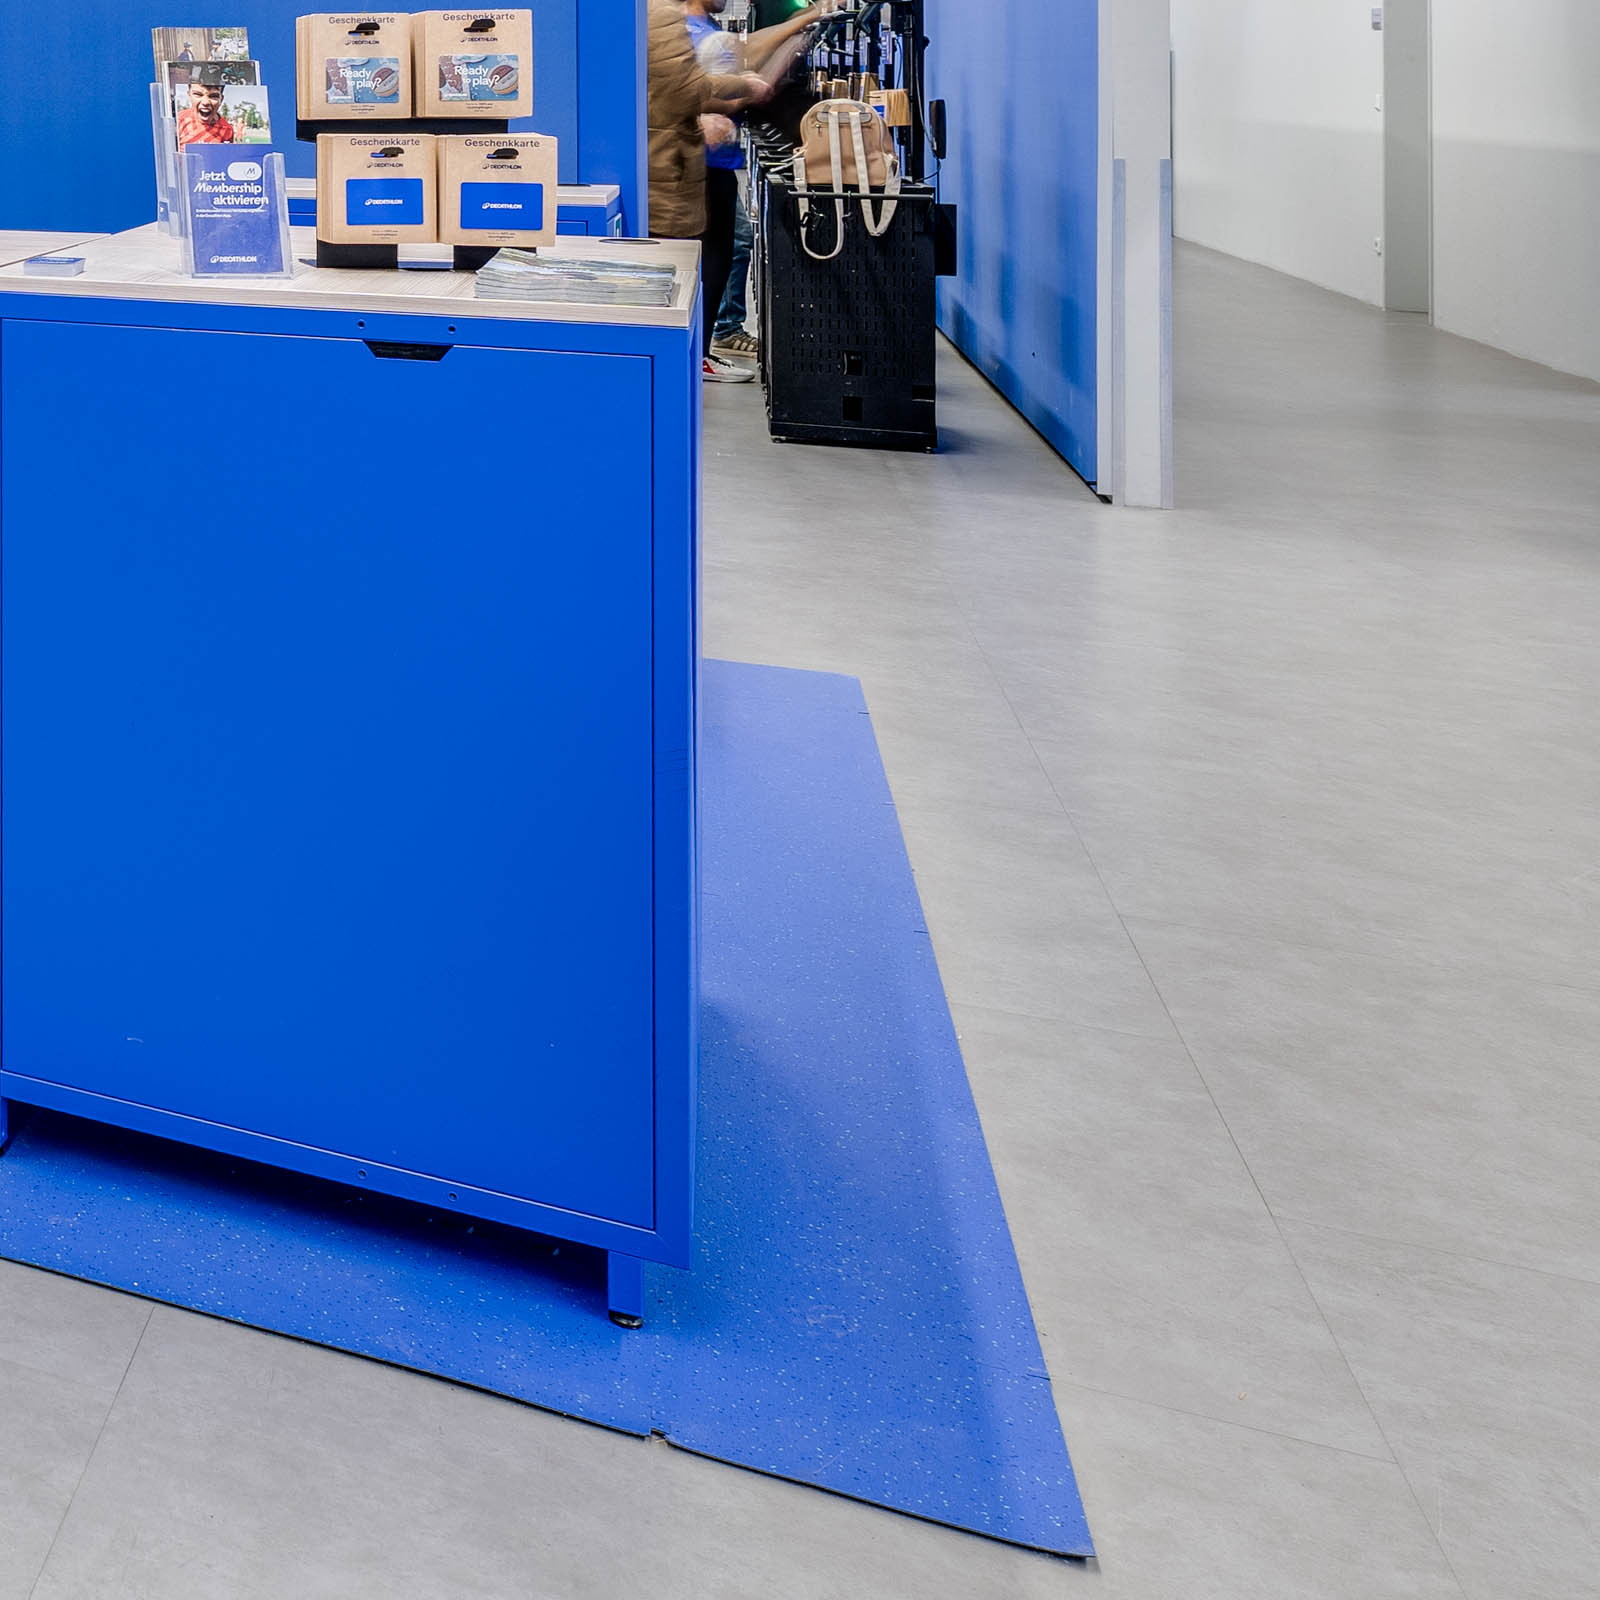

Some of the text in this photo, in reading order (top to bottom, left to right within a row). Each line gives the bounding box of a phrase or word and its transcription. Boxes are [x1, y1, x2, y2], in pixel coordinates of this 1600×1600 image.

[328, 16, 395, 24] Geschenkkarte
[442, 12, 515, 21] Geschenkkarte
[340, 68, 372, 79] Ready
[454, 65, 489, 77] Ready
[356, 78, 382, 91] play?
[472, 75, 500, 88] play?
[349, 137, 421, 146] Geschenkkarte
[464, 138, 541, 148] Geschenkkarte
[200, 170, 226, 181] Jetzt
[193, 182, 262, 195] Membership
[213, 194, 269, 205] aktivieren
[219, 255, 257, 263] DECATHLON
